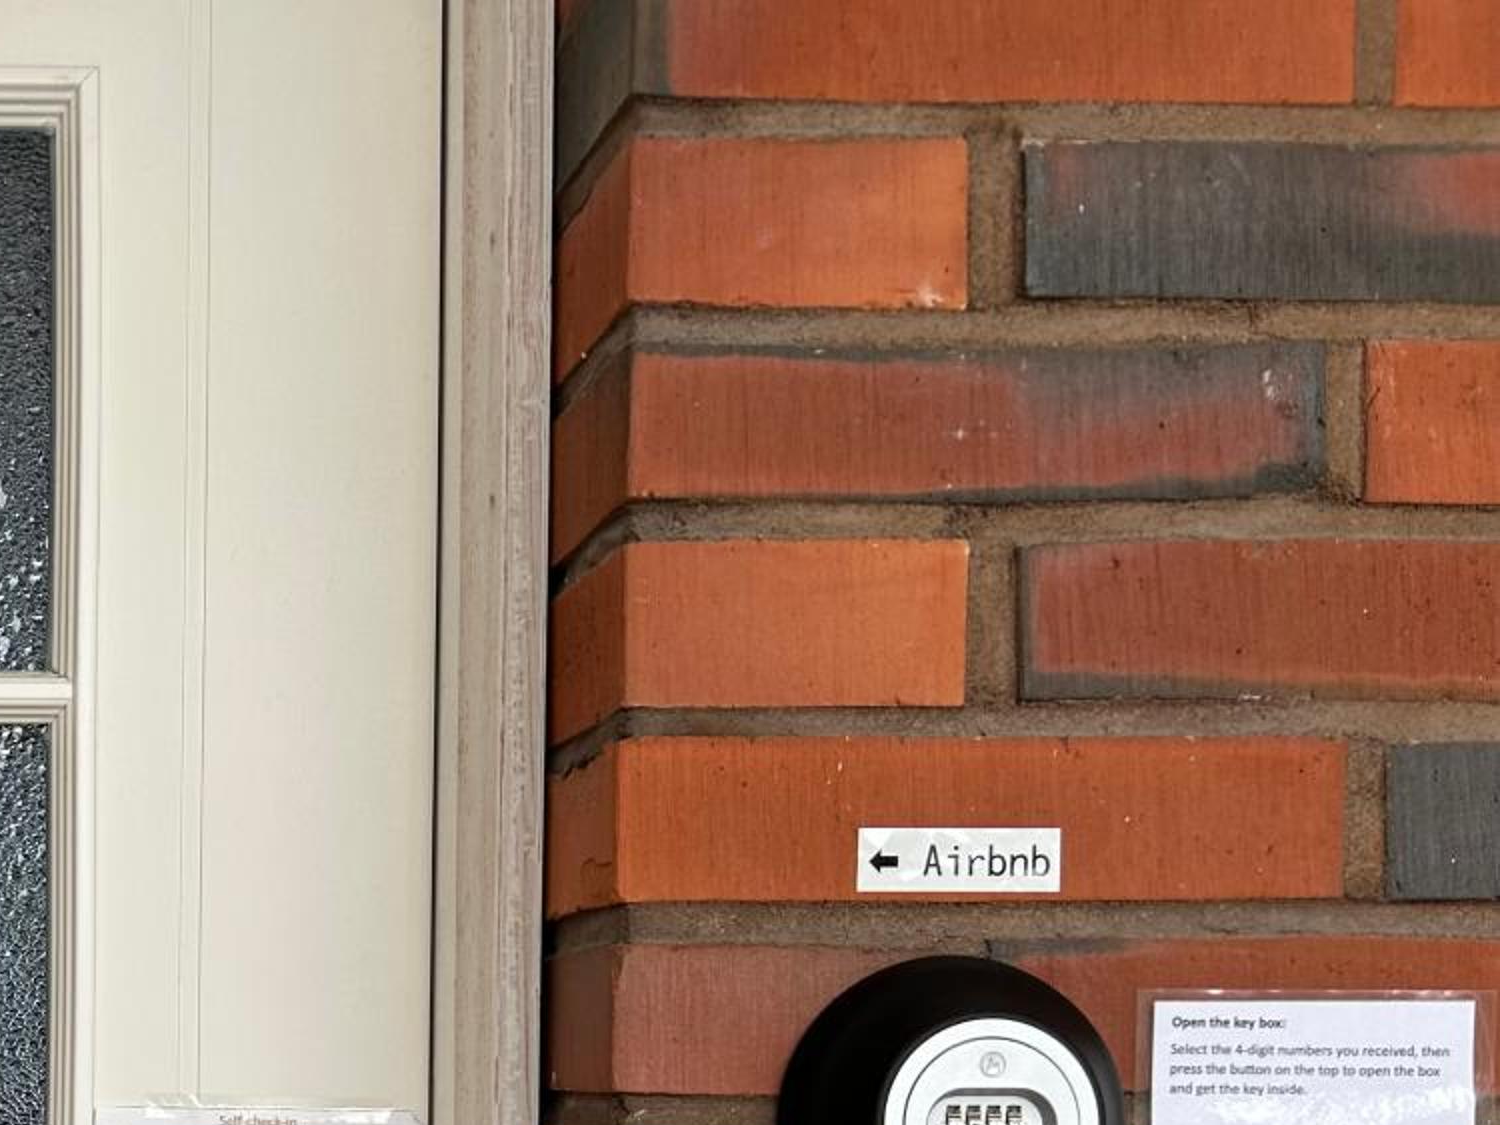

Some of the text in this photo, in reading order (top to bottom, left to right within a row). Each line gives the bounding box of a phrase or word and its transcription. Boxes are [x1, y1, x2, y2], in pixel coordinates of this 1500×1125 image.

[922, 843, 1051, 877] Airbnb
[1172, 1016, 1206, 1030] Open
[1209, 1016, 1230, 1028] the
[1233, 1016, 1256, 1030] key
[1170, 1043, 1450, 1059] Select the 4-digit numbers you received, then
[1169, 1062, 1441, 1078] press the button on the top to open the box
[1169, 1081, 1308, 1097] and get the key inside.
